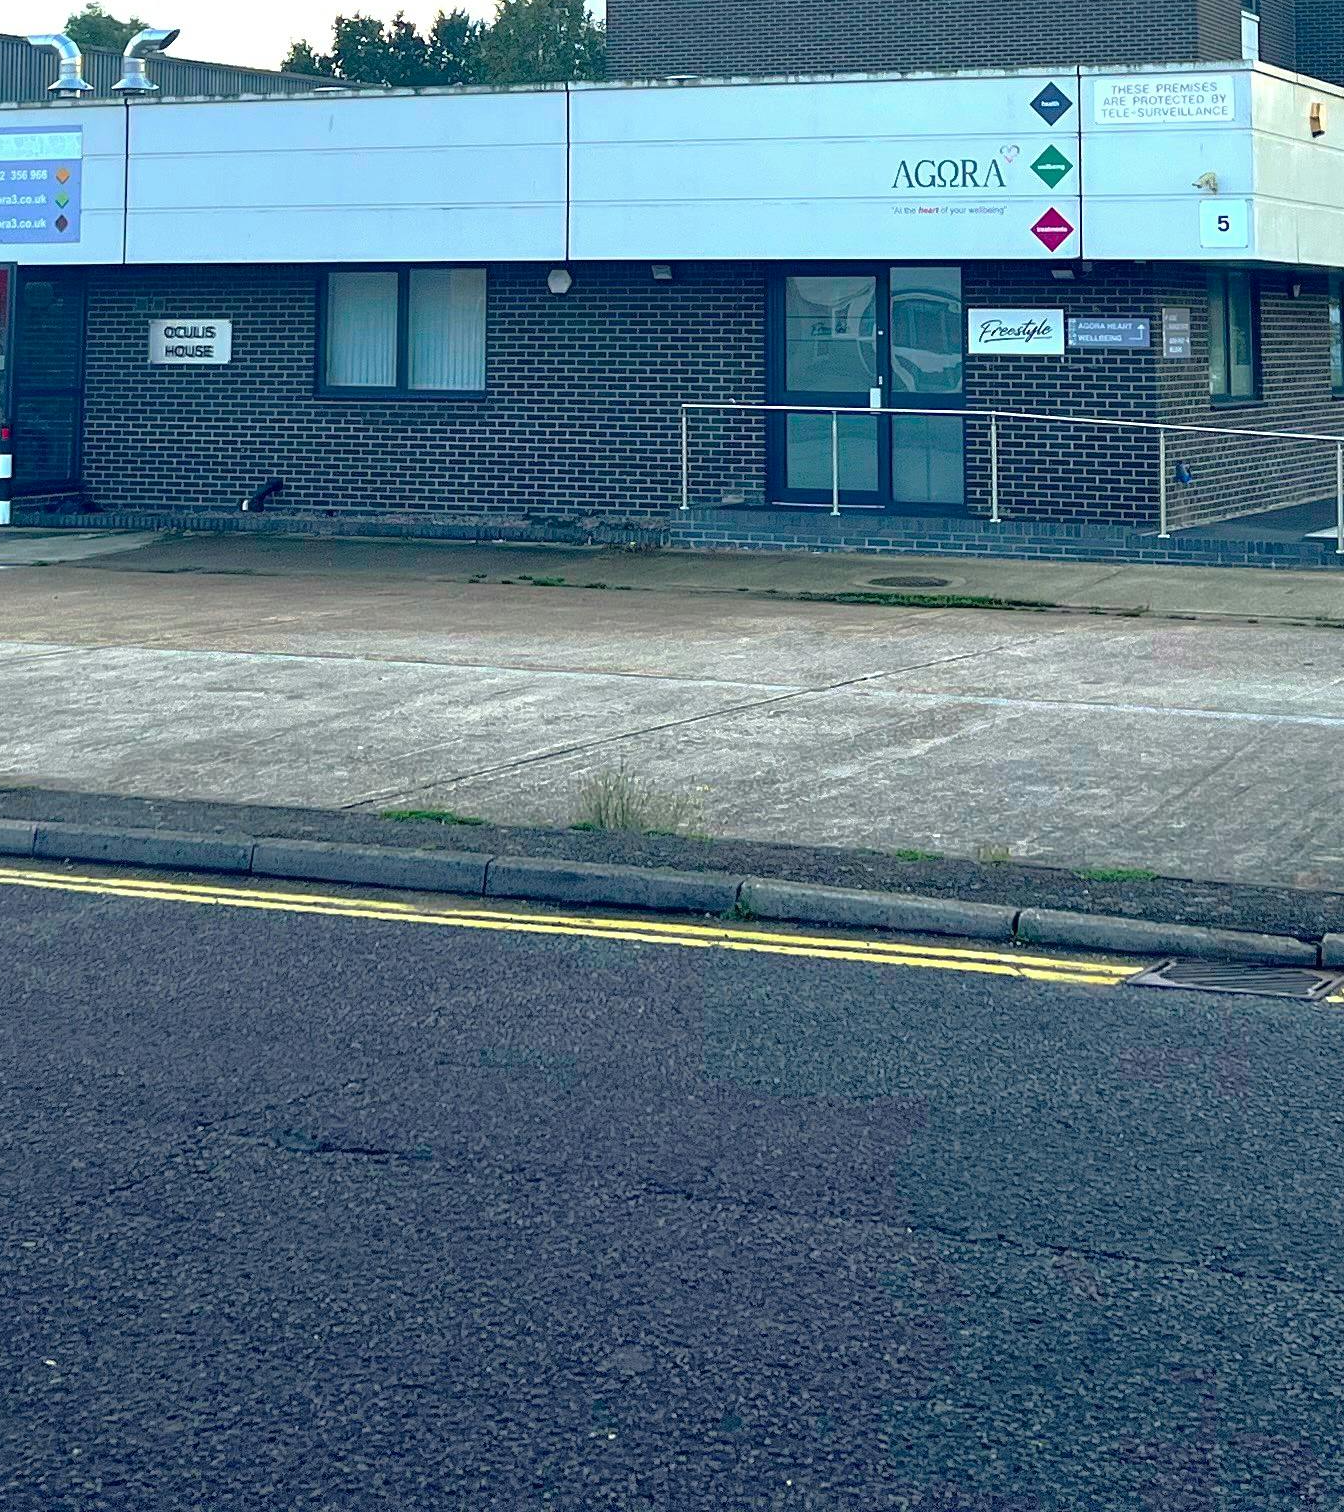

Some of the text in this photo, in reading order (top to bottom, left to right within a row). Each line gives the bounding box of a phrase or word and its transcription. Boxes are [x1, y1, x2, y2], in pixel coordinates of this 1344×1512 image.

[1111, 82, 1218, 95] THESE PREMISES
[1103, 94, 1227, 106] ARE PROTECTED BY
[1101, 106, 1229, 119] TELE-SURVEILLANCE
[918, 206, 939, 214] heart
[1217, 215, 1230, 232] 5
[164, 326, 217, 338] OCULIS
[978, 318, 1053, 343] Freestyle
[165, 345, 214, 358] HOUSE
